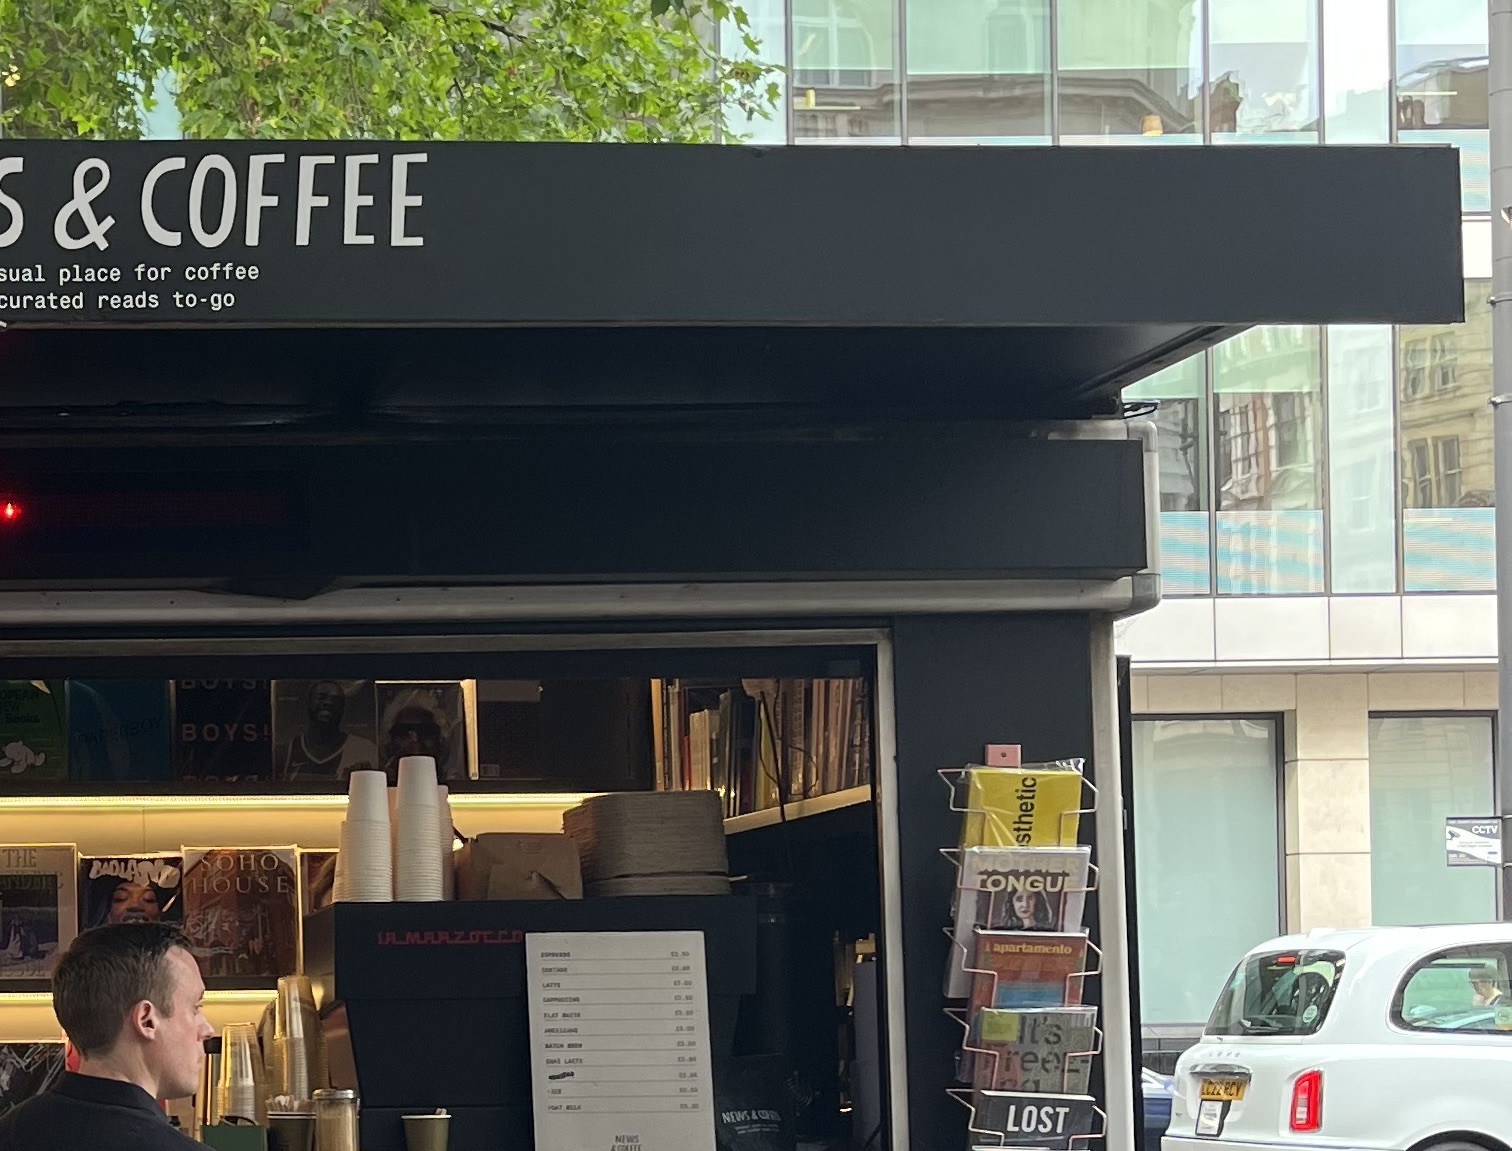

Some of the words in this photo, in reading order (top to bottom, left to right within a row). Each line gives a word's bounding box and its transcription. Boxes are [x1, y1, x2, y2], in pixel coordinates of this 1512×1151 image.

[53, 157, 116, 251] &
[140, 152, 429, 248] COFFEE
[59, 264, 121, 287] place
[133, 263, 172, 281] for
[184, 263, 260, 282] coffee
[97, 291, 160, 309] reads
[173, 290, 236, 313] to-go
[1472, 825, 1498, 834] CCTV
[201, 854, 279, 872] SOHO
[191, 875, 289, 894] HOUSE
[993, 942, 1072, 955] apartamento
[1006, 1104, 1070, 1134] LOST
[615, 1134, 640, 1144] NEWS
